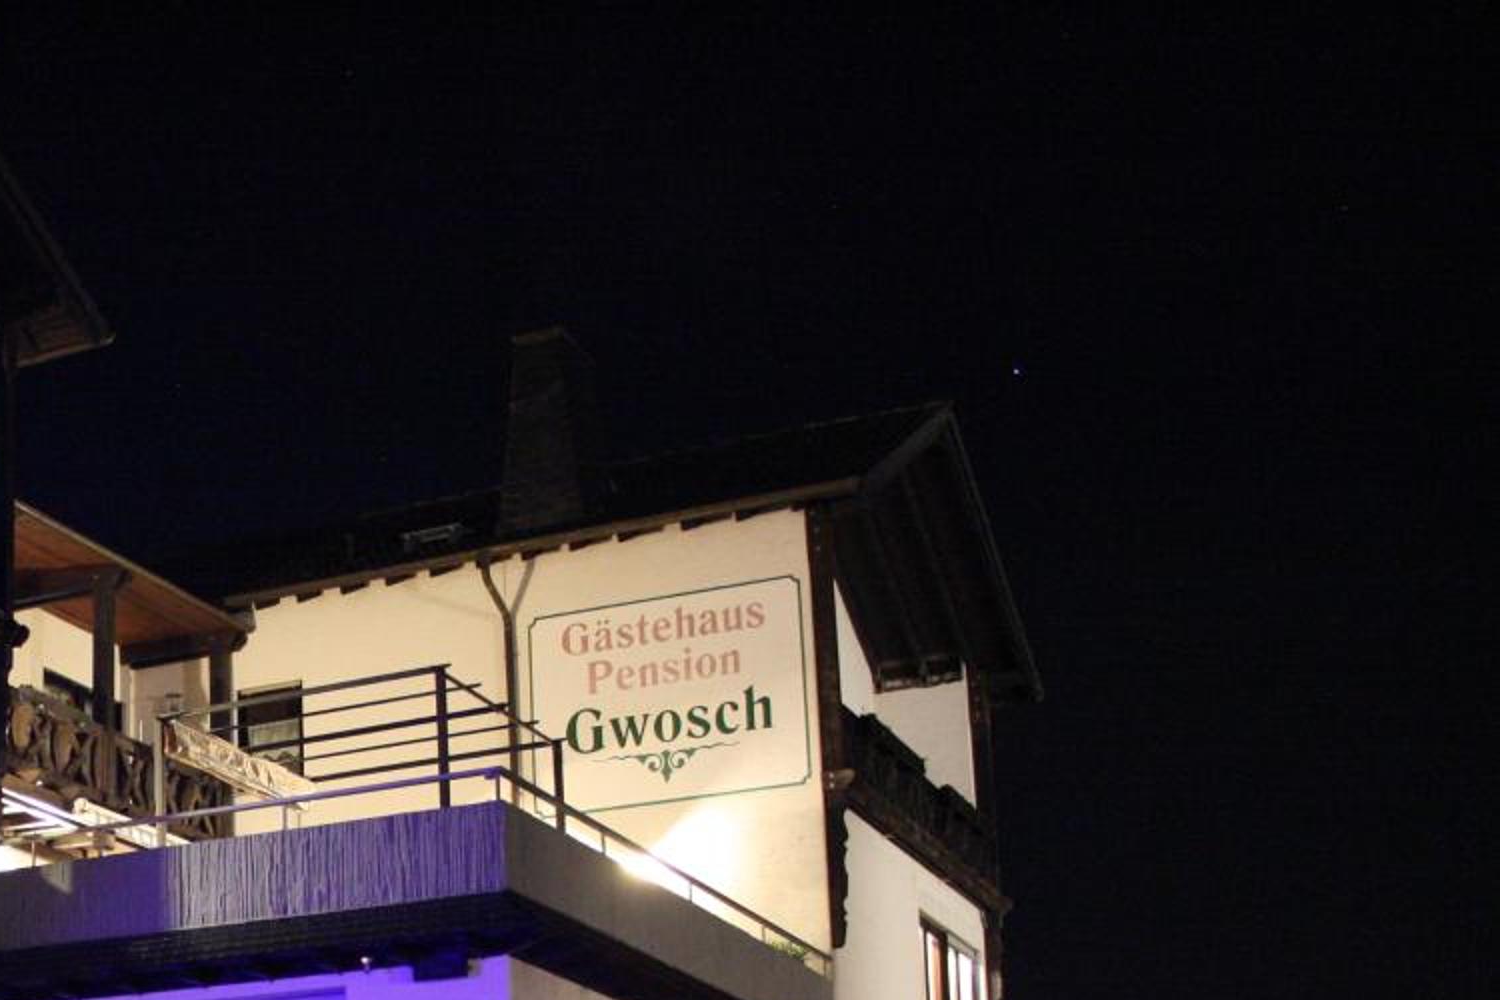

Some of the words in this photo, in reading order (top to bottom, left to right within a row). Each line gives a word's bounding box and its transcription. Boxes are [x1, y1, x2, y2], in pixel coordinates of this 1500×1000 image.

[561, 601, 765, 657] Gästehaus
[586, 647, 740, 695] Pension
[565, 684, 772, 755] Gwosch
